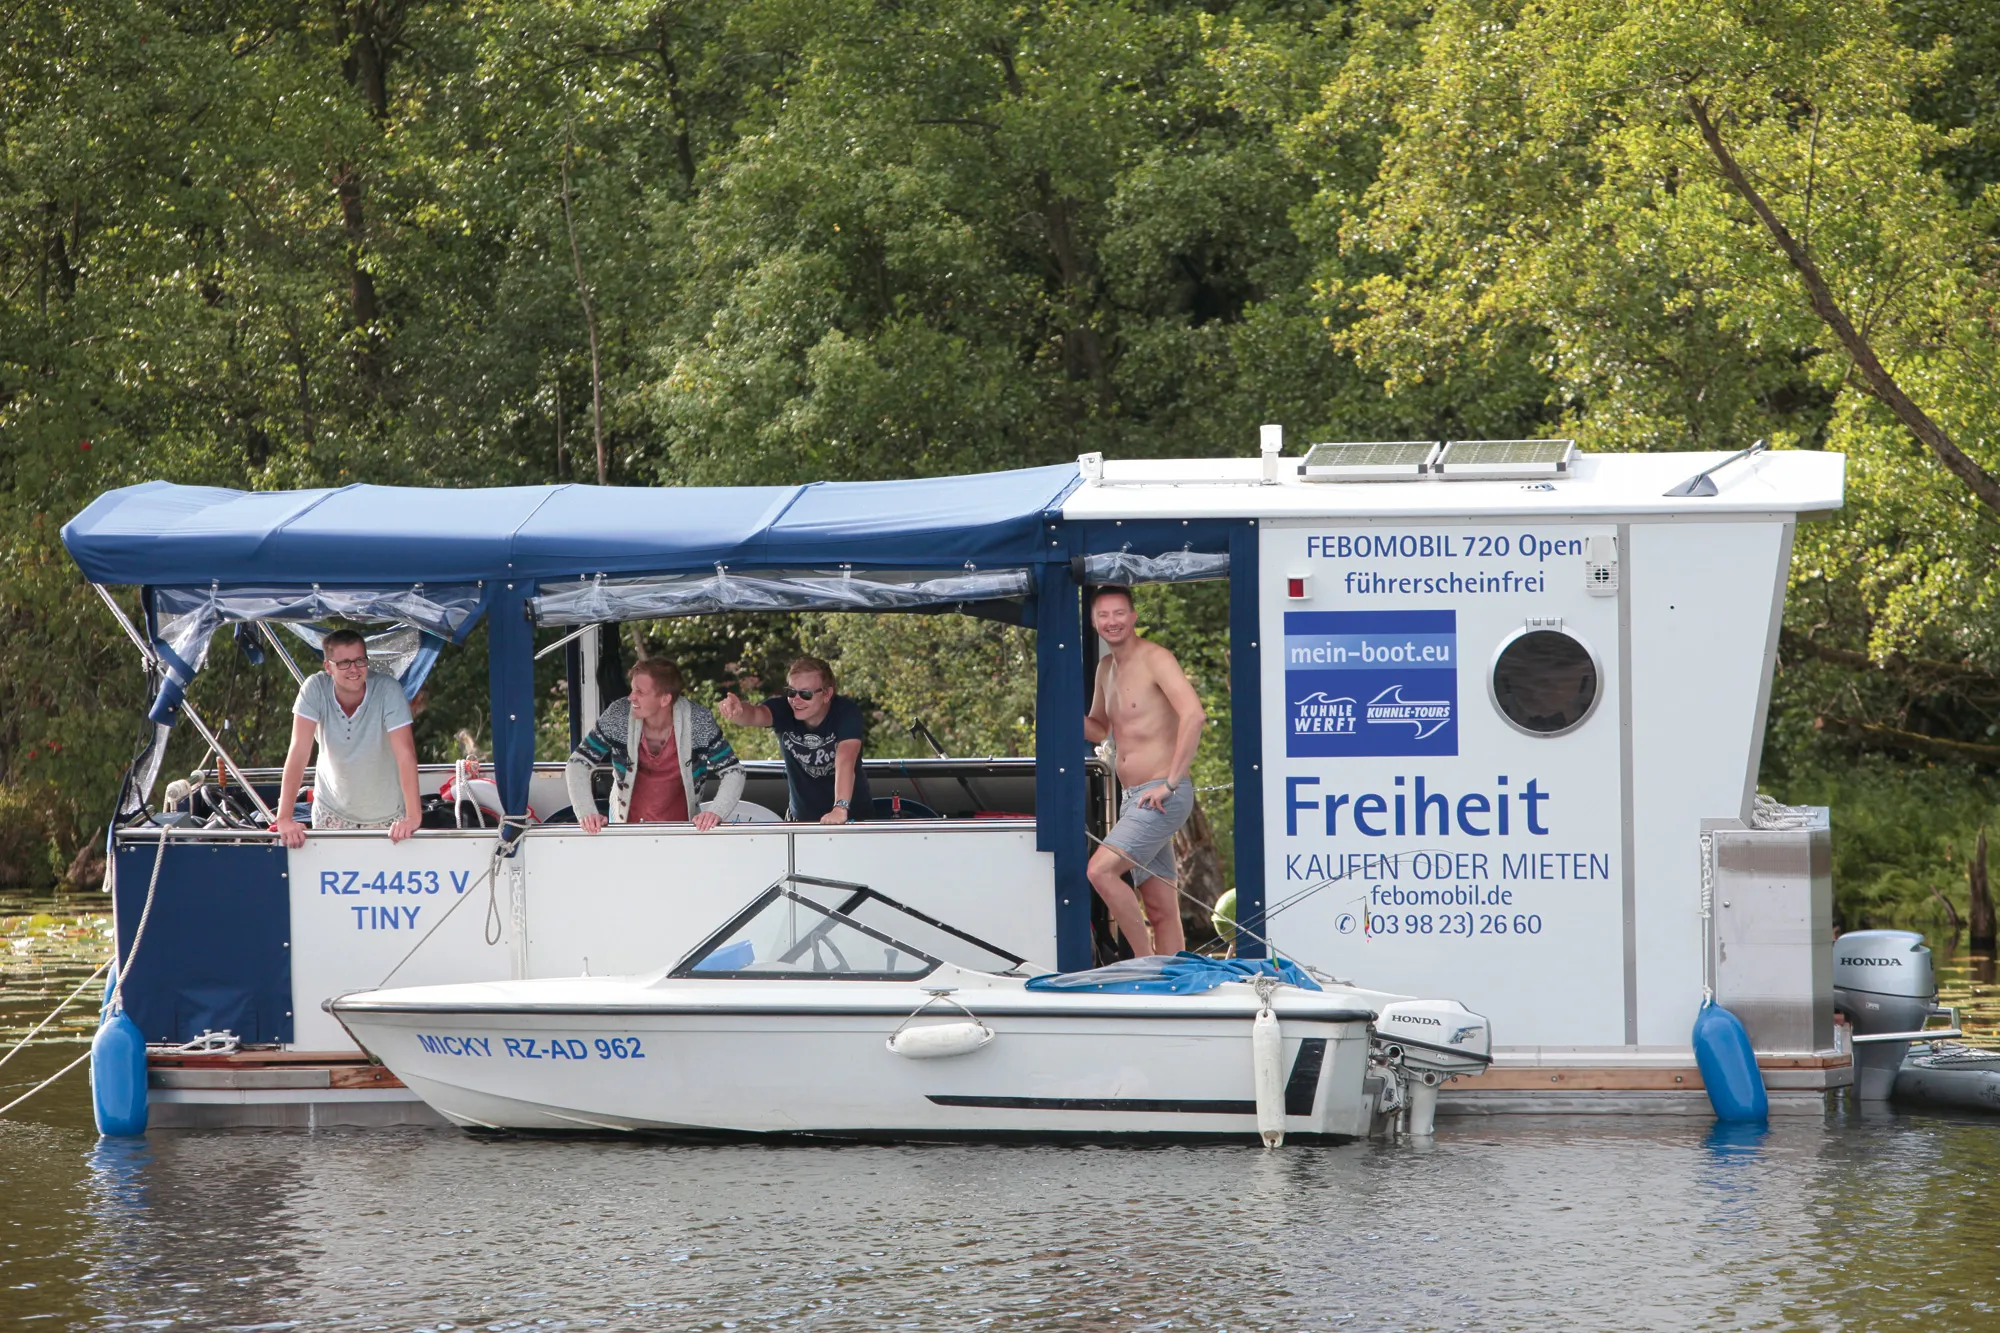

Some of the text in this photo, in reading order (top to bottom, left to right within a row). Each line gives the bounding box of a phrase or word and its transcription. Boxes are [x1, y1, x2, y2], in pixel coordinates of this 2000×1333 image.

[1307, 533, 1582, 562] FEBOMOBIL 720 Open
[1345, 570, 1545, 595] führerscheinfrei
[1291, 640, 1450, 664] mein-boot.eu
[1300, 704, 1353, 717] KUHNLE
[1366, 706, 1451, 718] KUHNLE-TOURS
[1294, 717, 1357, 732] WERFT
[1285, 774, 1550, 838] Freiheit
[1285, 853, 1609, 880] KAUFEN ODER MIETEN
[320, 869, 471, 895] RZ-4453 V
[1371, 884, 1513, 906] febomobil.de
[351, 905, 422, 930] TINY
[1405, 913, 1433, 935] 98
[1439, 911, 1474, 938] 23)
[1479, 913, 1507, 935] 26
[1513, 913, 1542, 935] 60
[1840, 956, 1903, 967] HONDA
[1391, 1014, 1442, 1026] HONDA
[417, 1034, 646, 1060] MICKY RZ-AD 962
